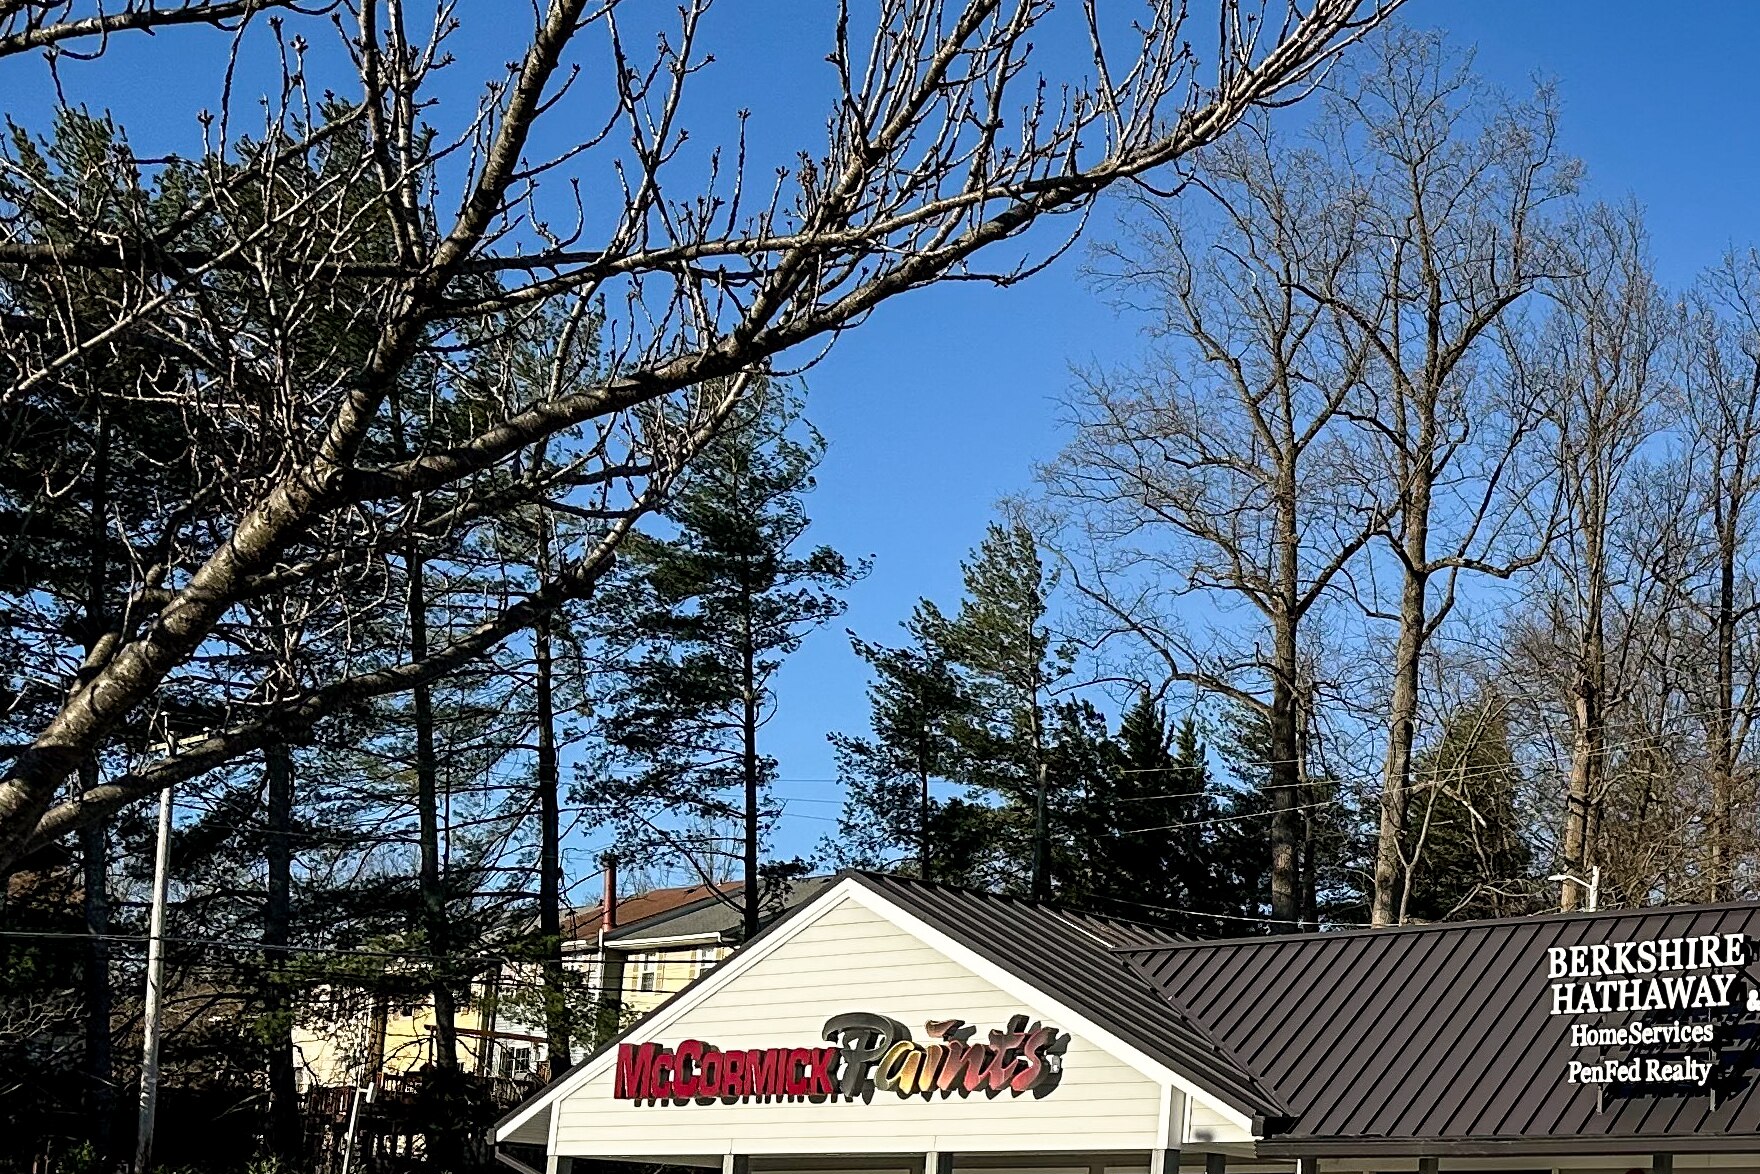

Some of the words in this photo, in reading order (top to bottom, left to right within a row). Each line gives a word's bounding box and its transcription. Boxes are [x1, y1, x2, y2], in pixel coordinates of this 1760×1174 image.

[1547, 933, 1745, 978] BERKSHIRE
[1550, 974, 1737, 1015] HATHAWAY
[1570, 1021, 1714, 1047] HomeServices
[822, 1012, 1056, 1098] Paints
[1568, 1058, 1641, 1084] PenFed
[1645, 1056, 1713, 1086] Realty
